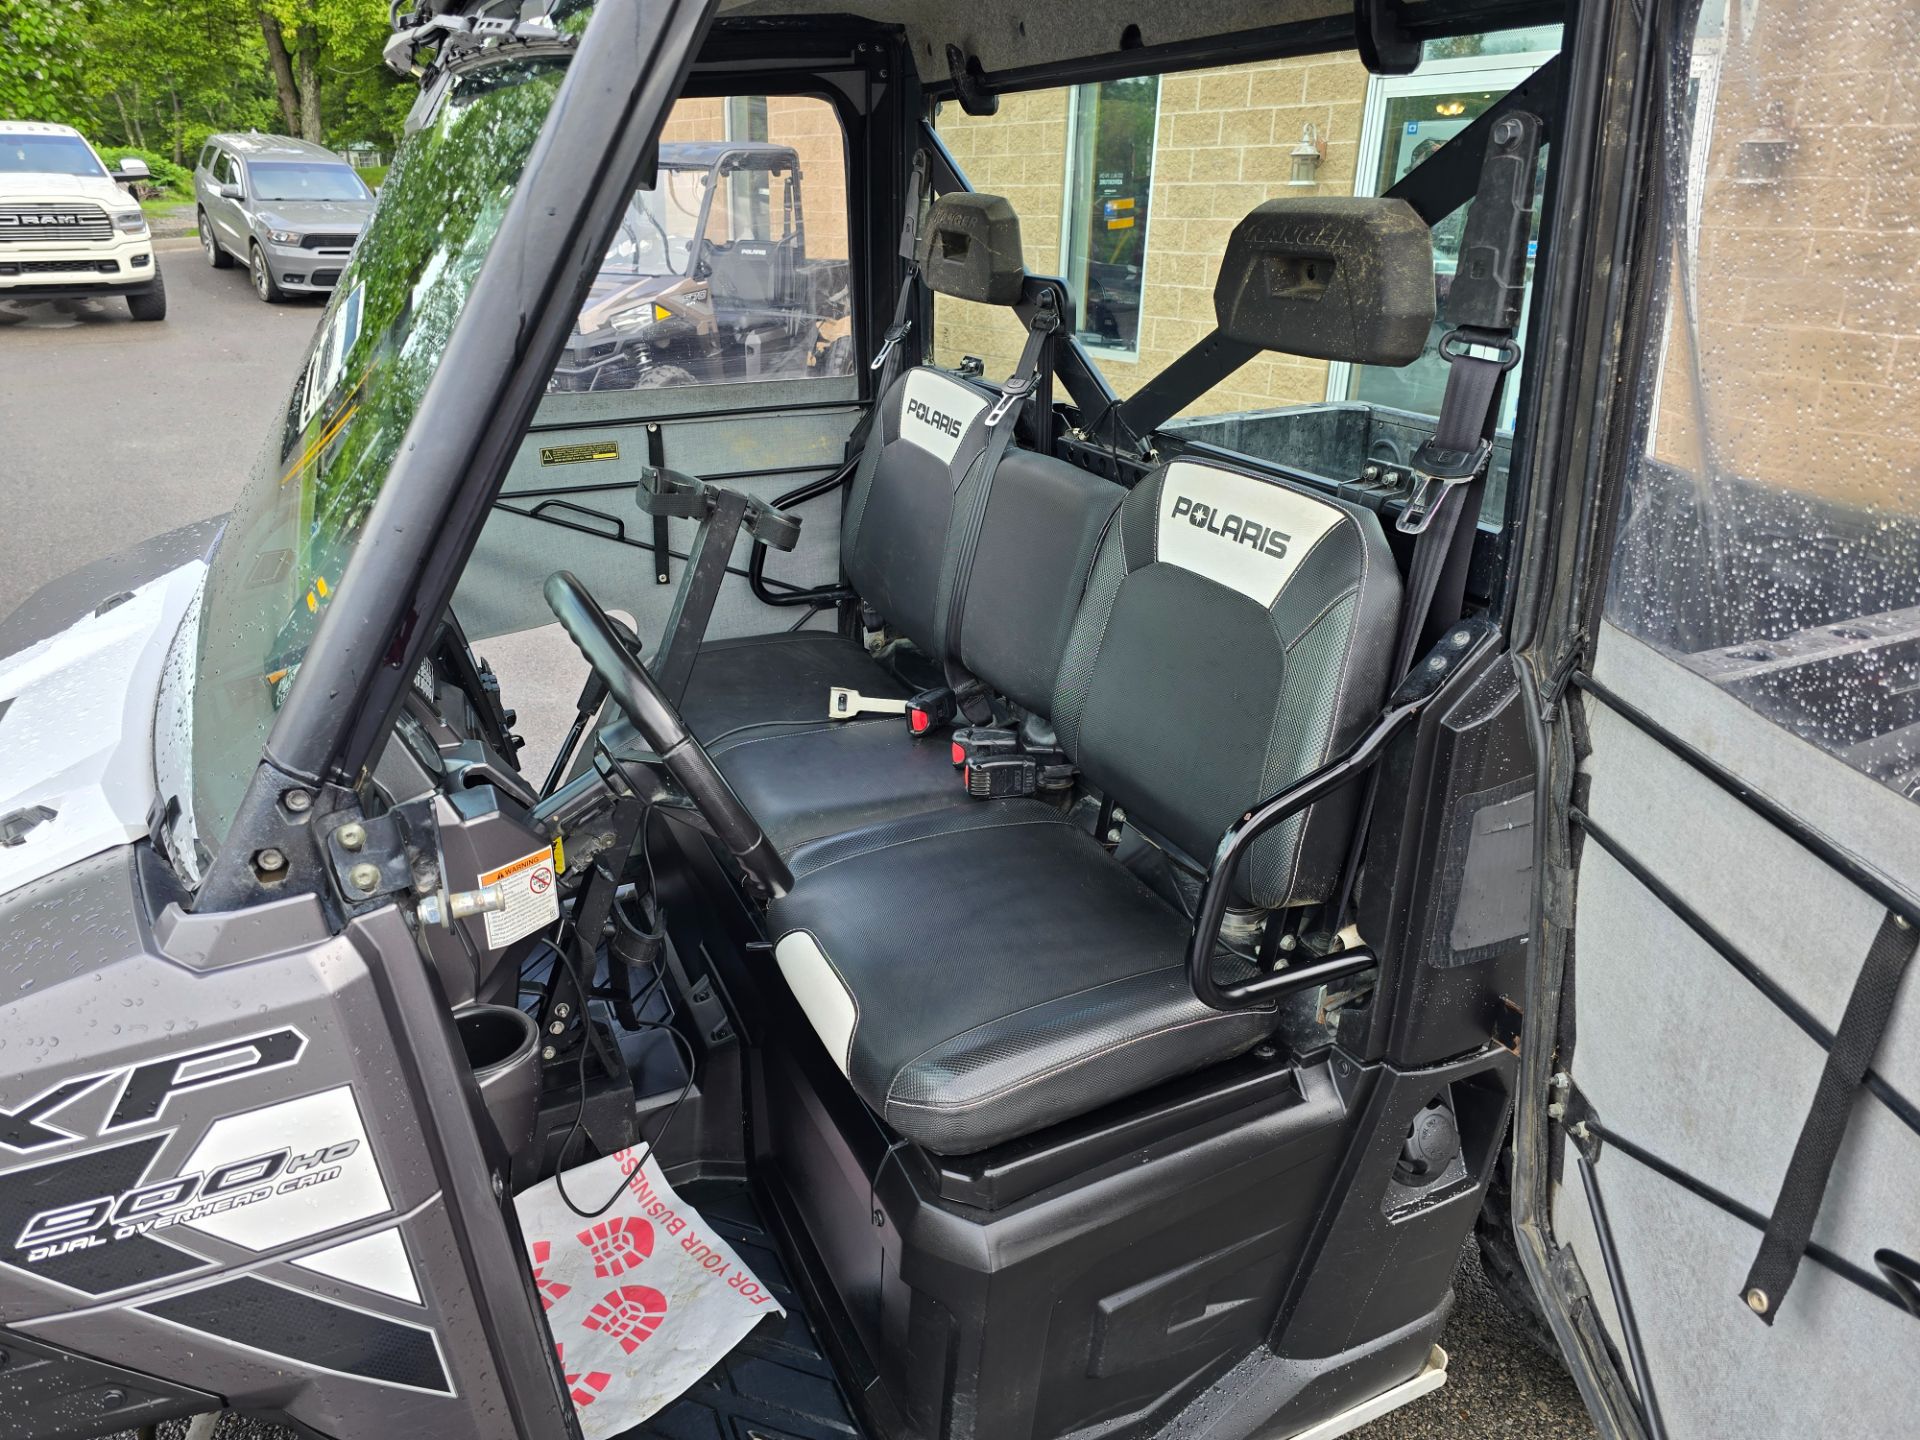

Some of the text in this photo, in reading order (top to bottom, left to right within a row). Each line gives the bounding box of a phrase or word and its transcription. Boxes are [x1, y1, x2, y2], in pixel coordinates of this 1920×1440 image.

[20, 215, 76, 225] RAM
[907, 397, 962, 439] POLARIS
[1171, 495, 1292, 560] POLARIS
[504, 856, 540, 877] WARNING
[15, 1139, 360, 1249] 900 HO
[28, 1164, 342, 1263] DUAL OVERHEAD CAM
[680, 1231, 732, 1277] YOUR
[727, 1271, 772, 1305] FOR
